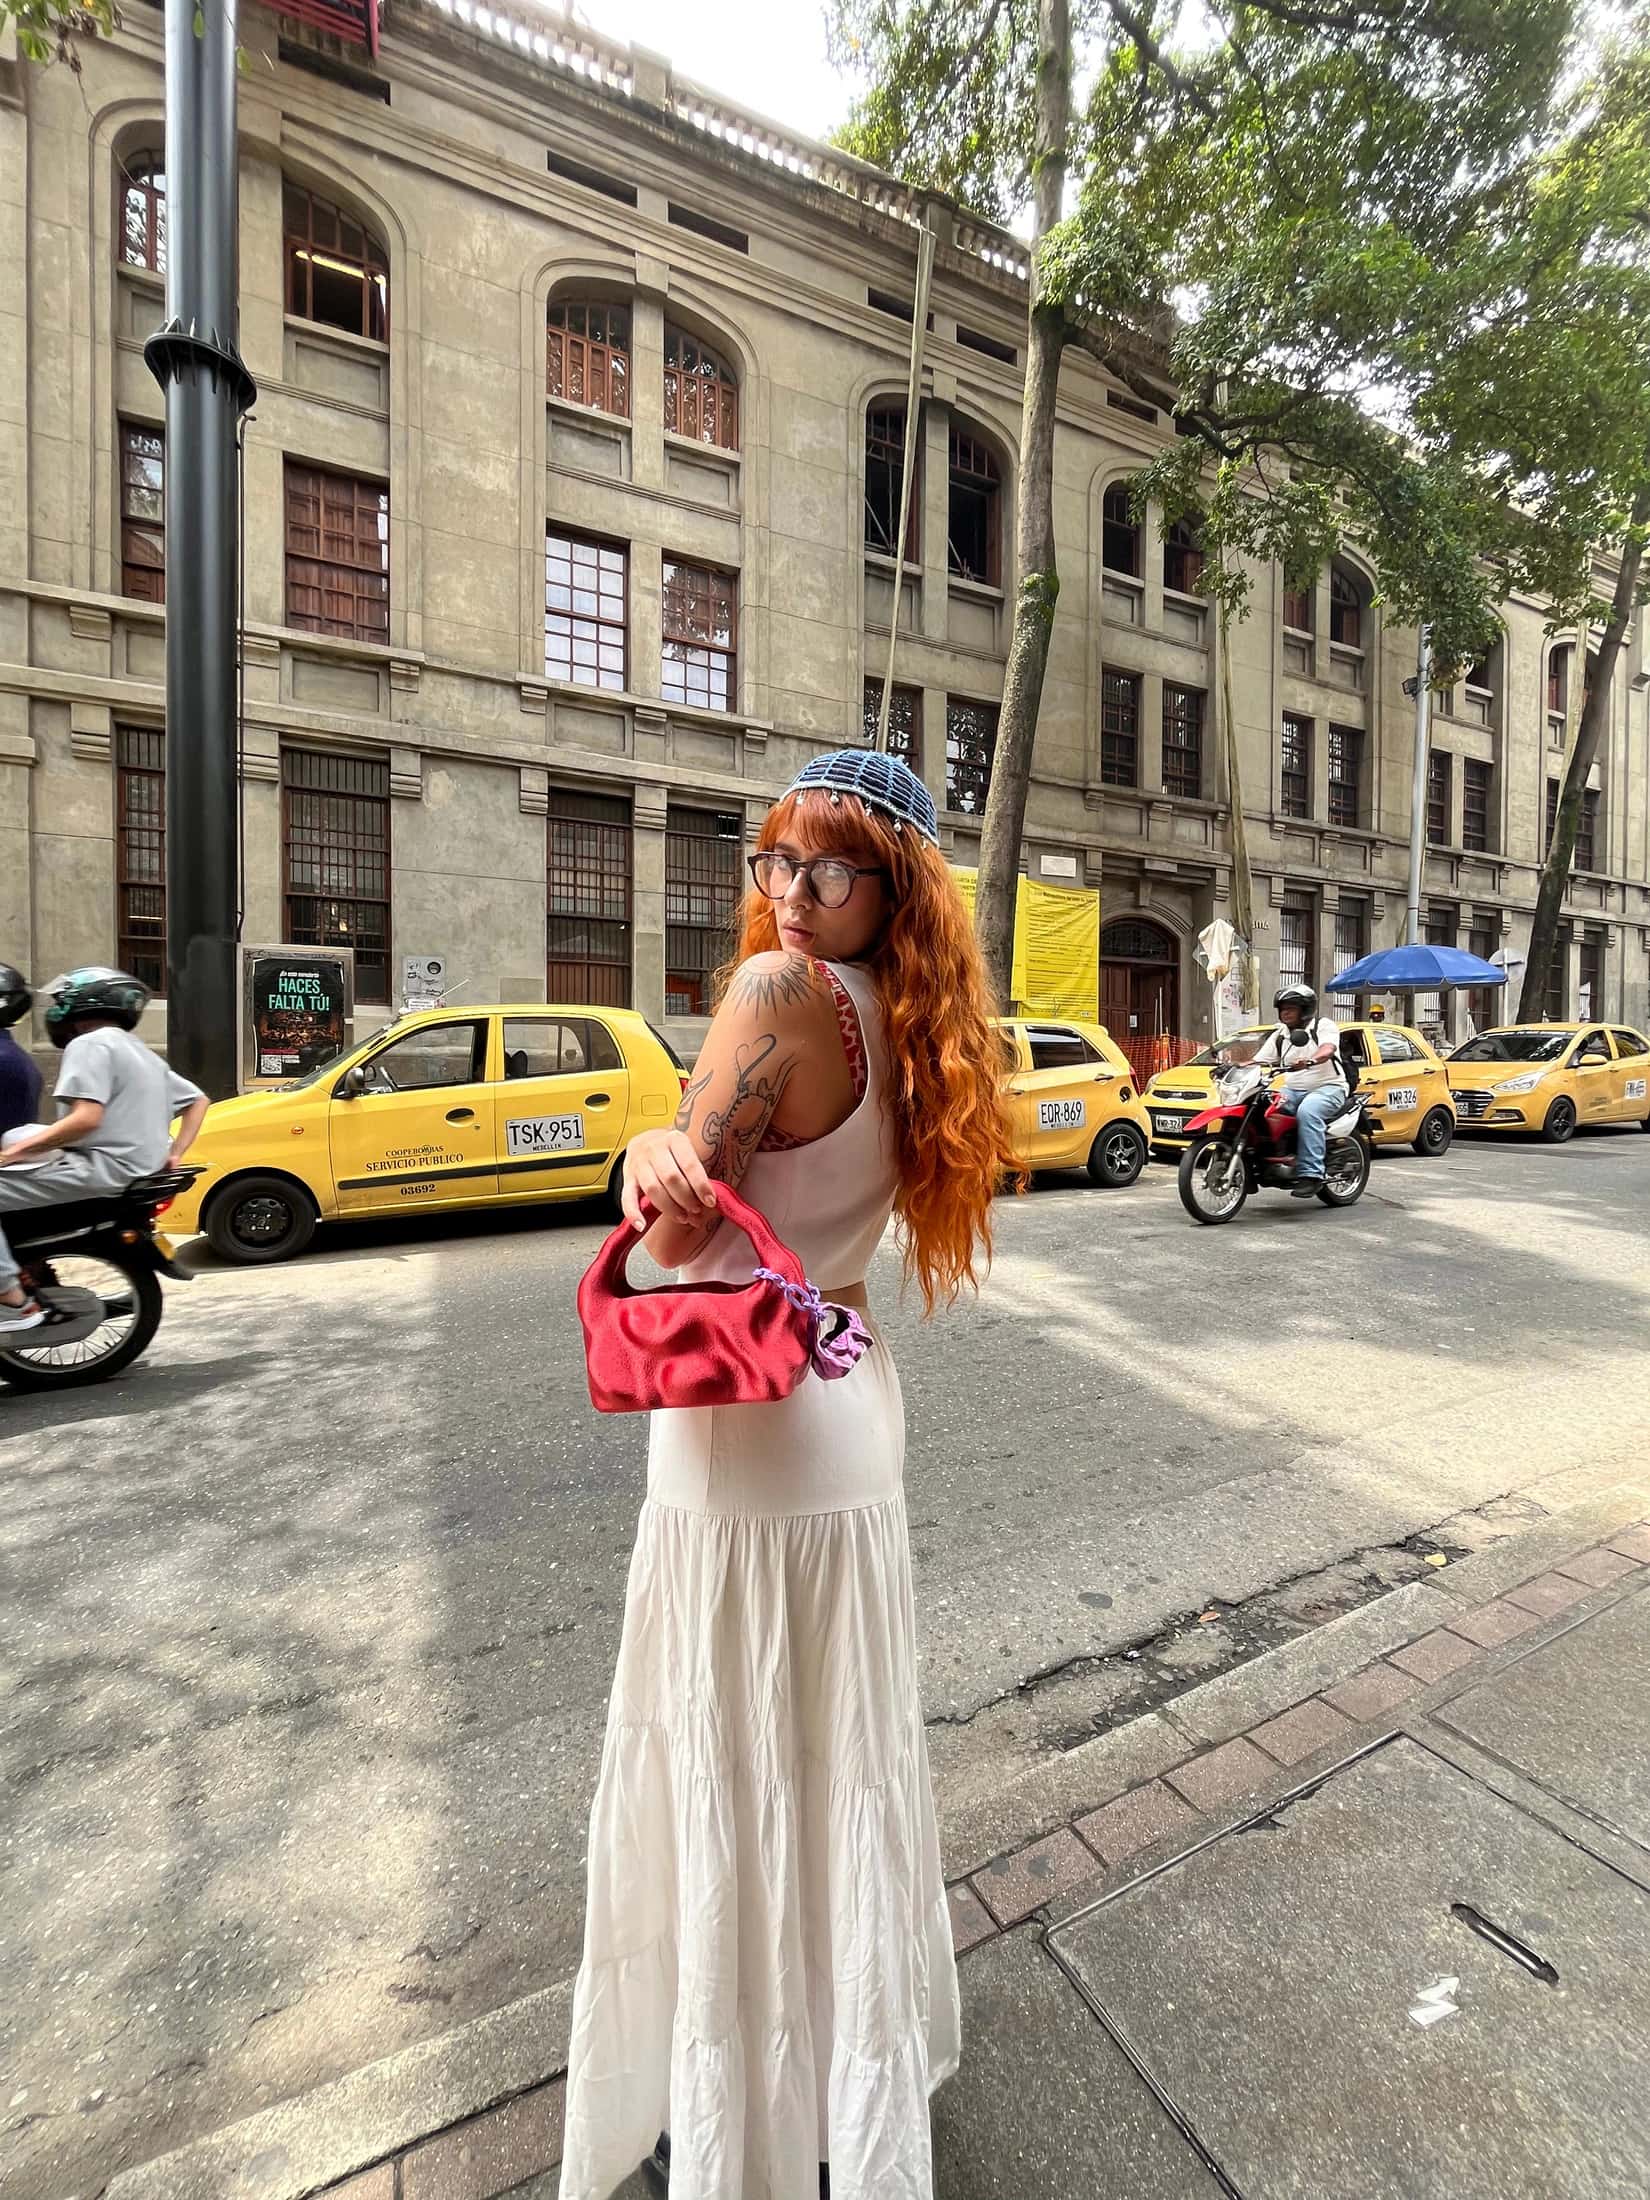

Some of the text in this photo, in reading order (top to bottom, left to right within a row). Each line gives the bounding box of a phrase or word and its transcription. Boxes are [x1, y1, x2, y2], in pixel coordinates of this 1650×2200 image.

[278, 977, 321, 994] HACES
[268, 993, 330, 1011] FALTA TÚ!
[366, 1153, 464, 1172] SERVICIO PUBLICO
[400, 1183, 436, 1196] 03692
